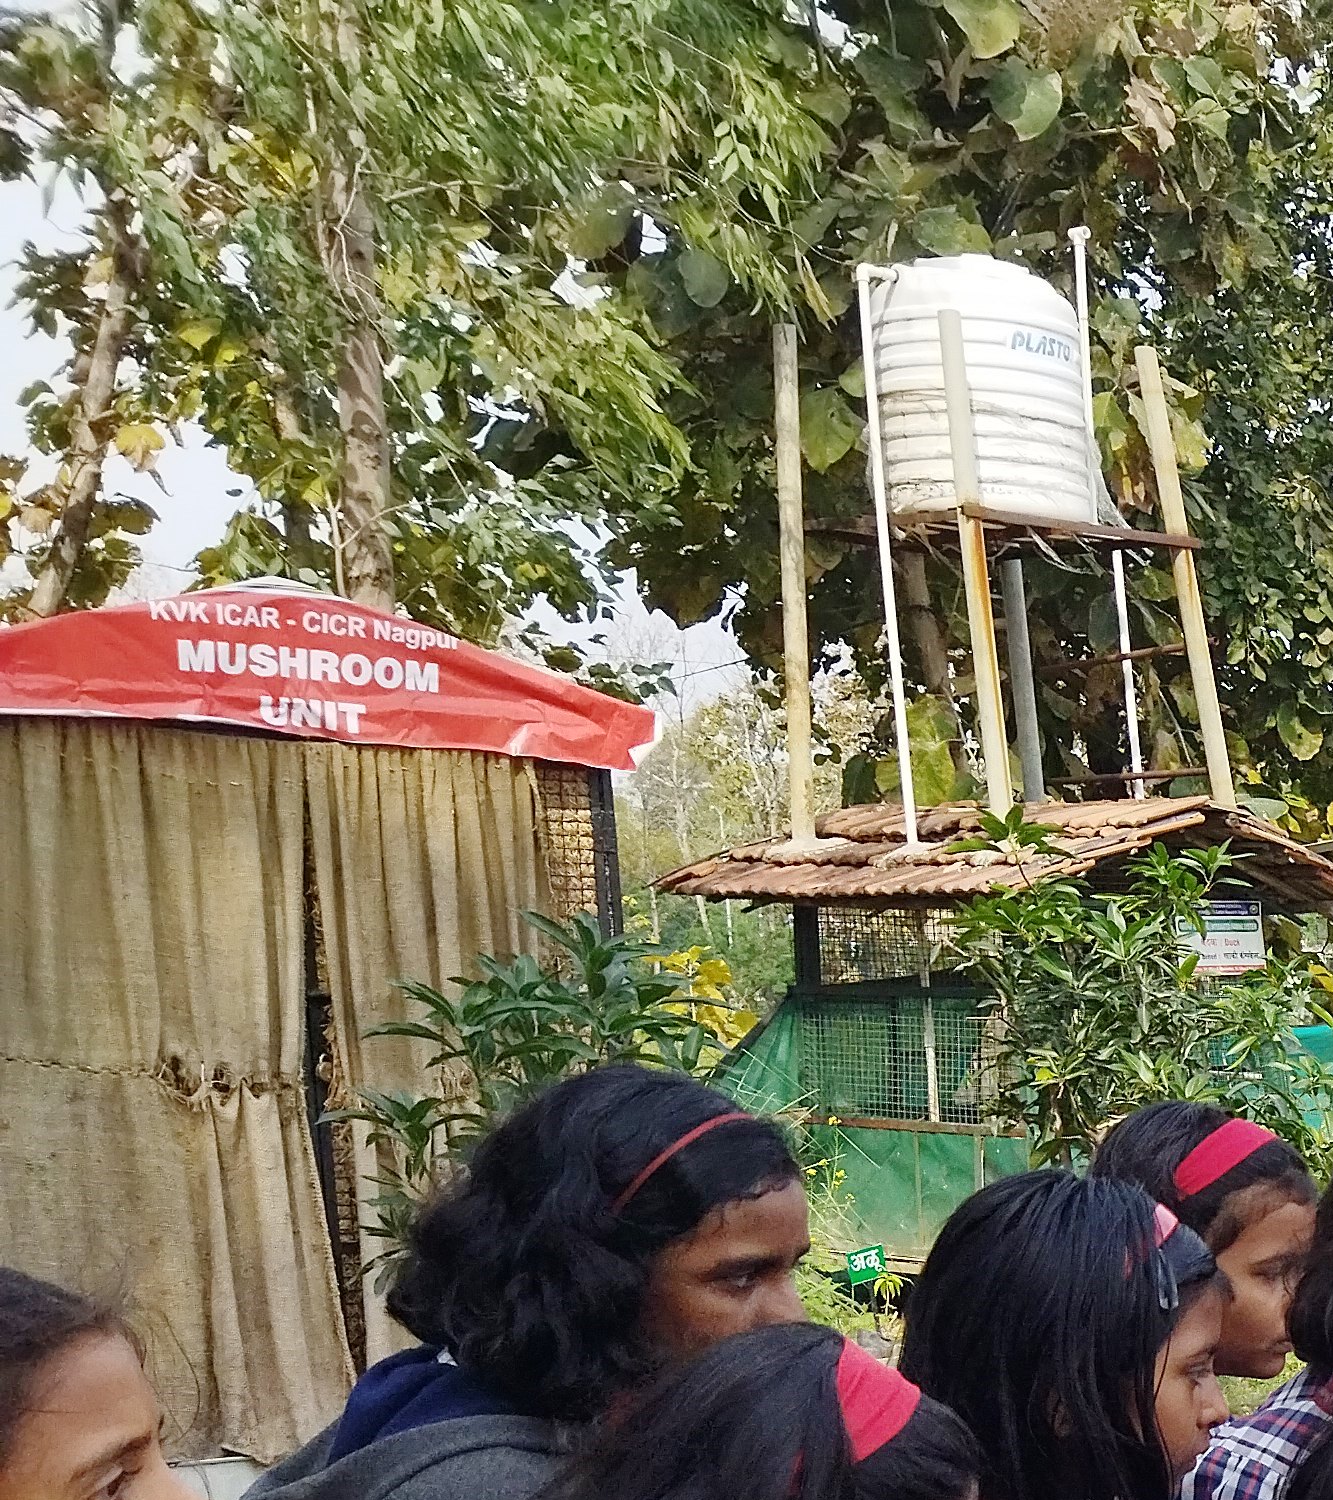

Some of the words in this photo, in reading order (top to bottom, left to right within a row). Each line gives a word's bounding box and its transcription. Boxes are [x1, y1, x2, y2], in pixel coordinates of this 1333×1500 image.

[1011, 331, 1074, 362] PLASTO
[149, 600, 211, 625] KVK
[216, 604, 279, 630] ICAR
[302, 610, 367, 639] CICR
[372, 622, 459, 653] Nagpur
[177, 639, 440, 694] MUSHROOM
[258, 694, 367, 735] UNIT
